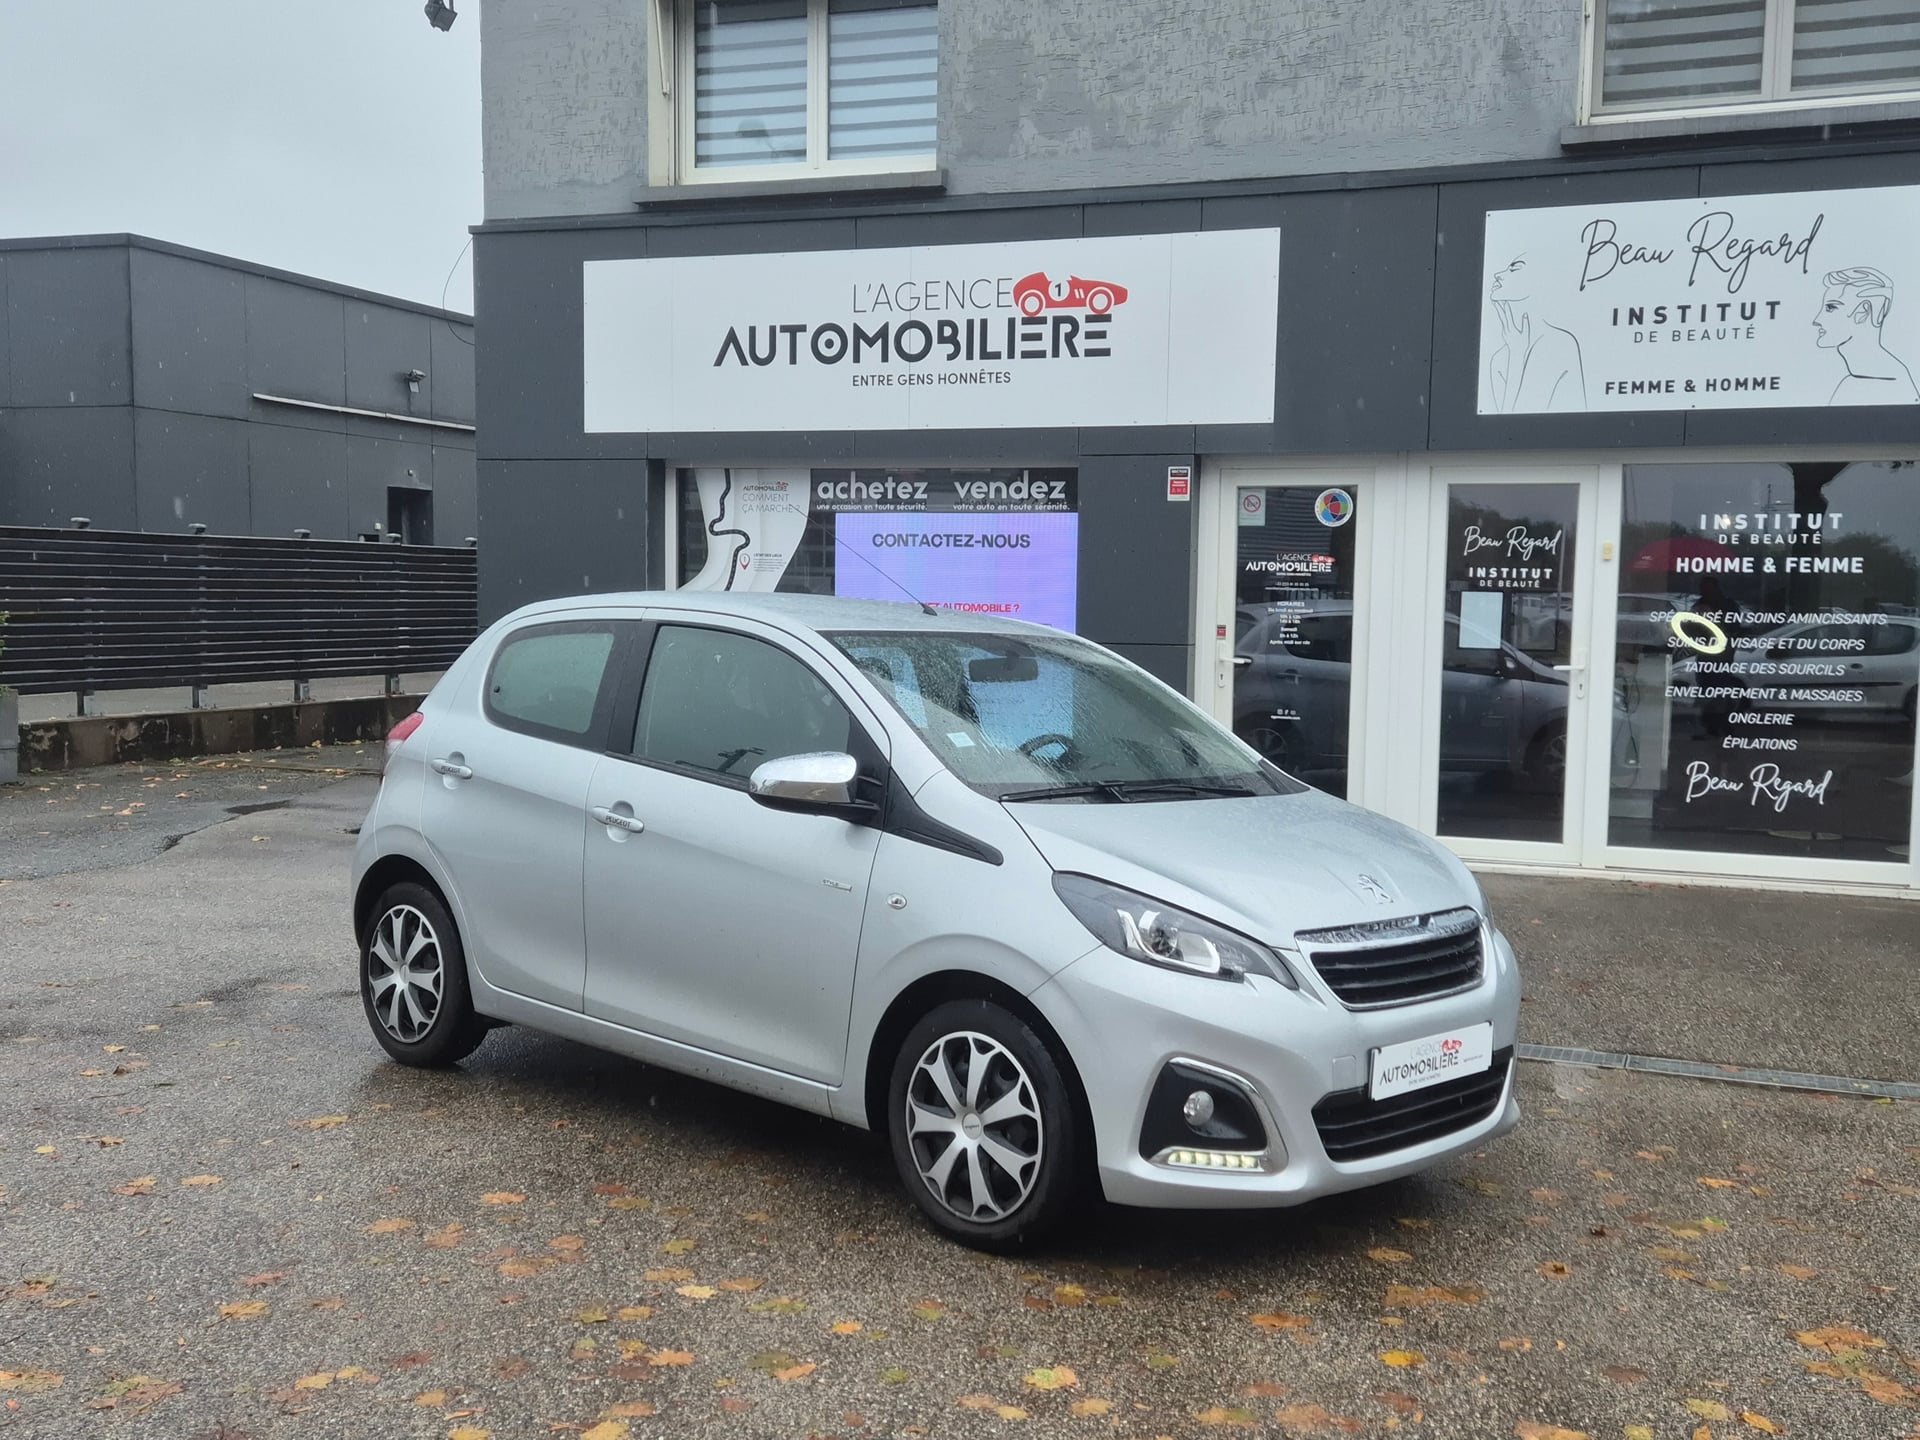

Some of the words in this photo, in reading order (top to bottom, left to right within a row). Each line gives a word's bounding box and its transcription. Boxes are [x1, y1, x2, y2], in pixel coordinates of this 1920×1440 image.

[1579, 219, 1674, 292] Beau
[1686, 211, 1825, 294] Regard
[851, 277, 1014, 313] L'AGENCE
[1054, 281, 1063, 297] 1
[1612, 301, 1782, 326] INSTITUT
[1634, 331, 1658, 343] DE
[1671, 324, 1756, 342] BEAUTÉ
[852, 373, 894, 387] ENTRE
[897, 372, 935, 386] GENS
[937, 368, 1012, 385] HONNÊTES
[1605, 380, 1675, 395] FEMME
[1684, 379, 1697, 393] &
[1705, 376, 1781, 392] HOMME
[817, 471, 929, 499] achetez
[954, 470, 1066, 499] vendez
[742, 493, 790, 502] COMMENT
[742, 503, 754, 514] ÇA
[756, 504, 793, 513] MARCHE
[832, 502, 862, 510] occasion
[1701, 513, 1843, 530] INSTITUT
[872, 533, 1031, 548] CONTACTEZ-NOUS
[1464, 526, 1503, 556] Beau
[1507, 526, 1562, 561] Regard
[1718, 534, 1740, 545] DE
[1750, 531, 1823, 545] BEAUTÉ
[1468, 567, 1553, 579] INSTITUT
[1676, 557, 1754, 573] HOMME
[1763, 557, 1777, 573] &
[1785, 557, 1864, 573] FEMME
[1498, 580, 1540, 588] BEAUTÉ
[1724, 612, 1744, 624] EN
[1744, 612, 1786, 624] SOINS
[1787, 612, 1888, 625] AMINCISSANTS
[1730, 638, 1776, 650] VISAGE
[1778, 638, 1796, 650] ET
[1797, 638, 1818, 650] DU
[1820, 638, 1866, 651] CORPS
[1684, 661, 1747, 674] TATOUAGE
[1749, 663, 1776, 675] DES
[1778, 663, 1846, 676] SOURCILS
[1665, 686, 1776, 700] ENVELOPPEMENT
[1778, 688, 1788, 700] &
[1790, 689, 1864, 702] MASSAGES
[1728, 712, 1795, 726] ONGLERIE
[1722, 735, 1798, 751] ÉPILATIONS
[1685, 761, 1744, 803] Beau
[1750, 763, 1833, 813] Regard
[605, 815, 631, 828] PEUGEOT
